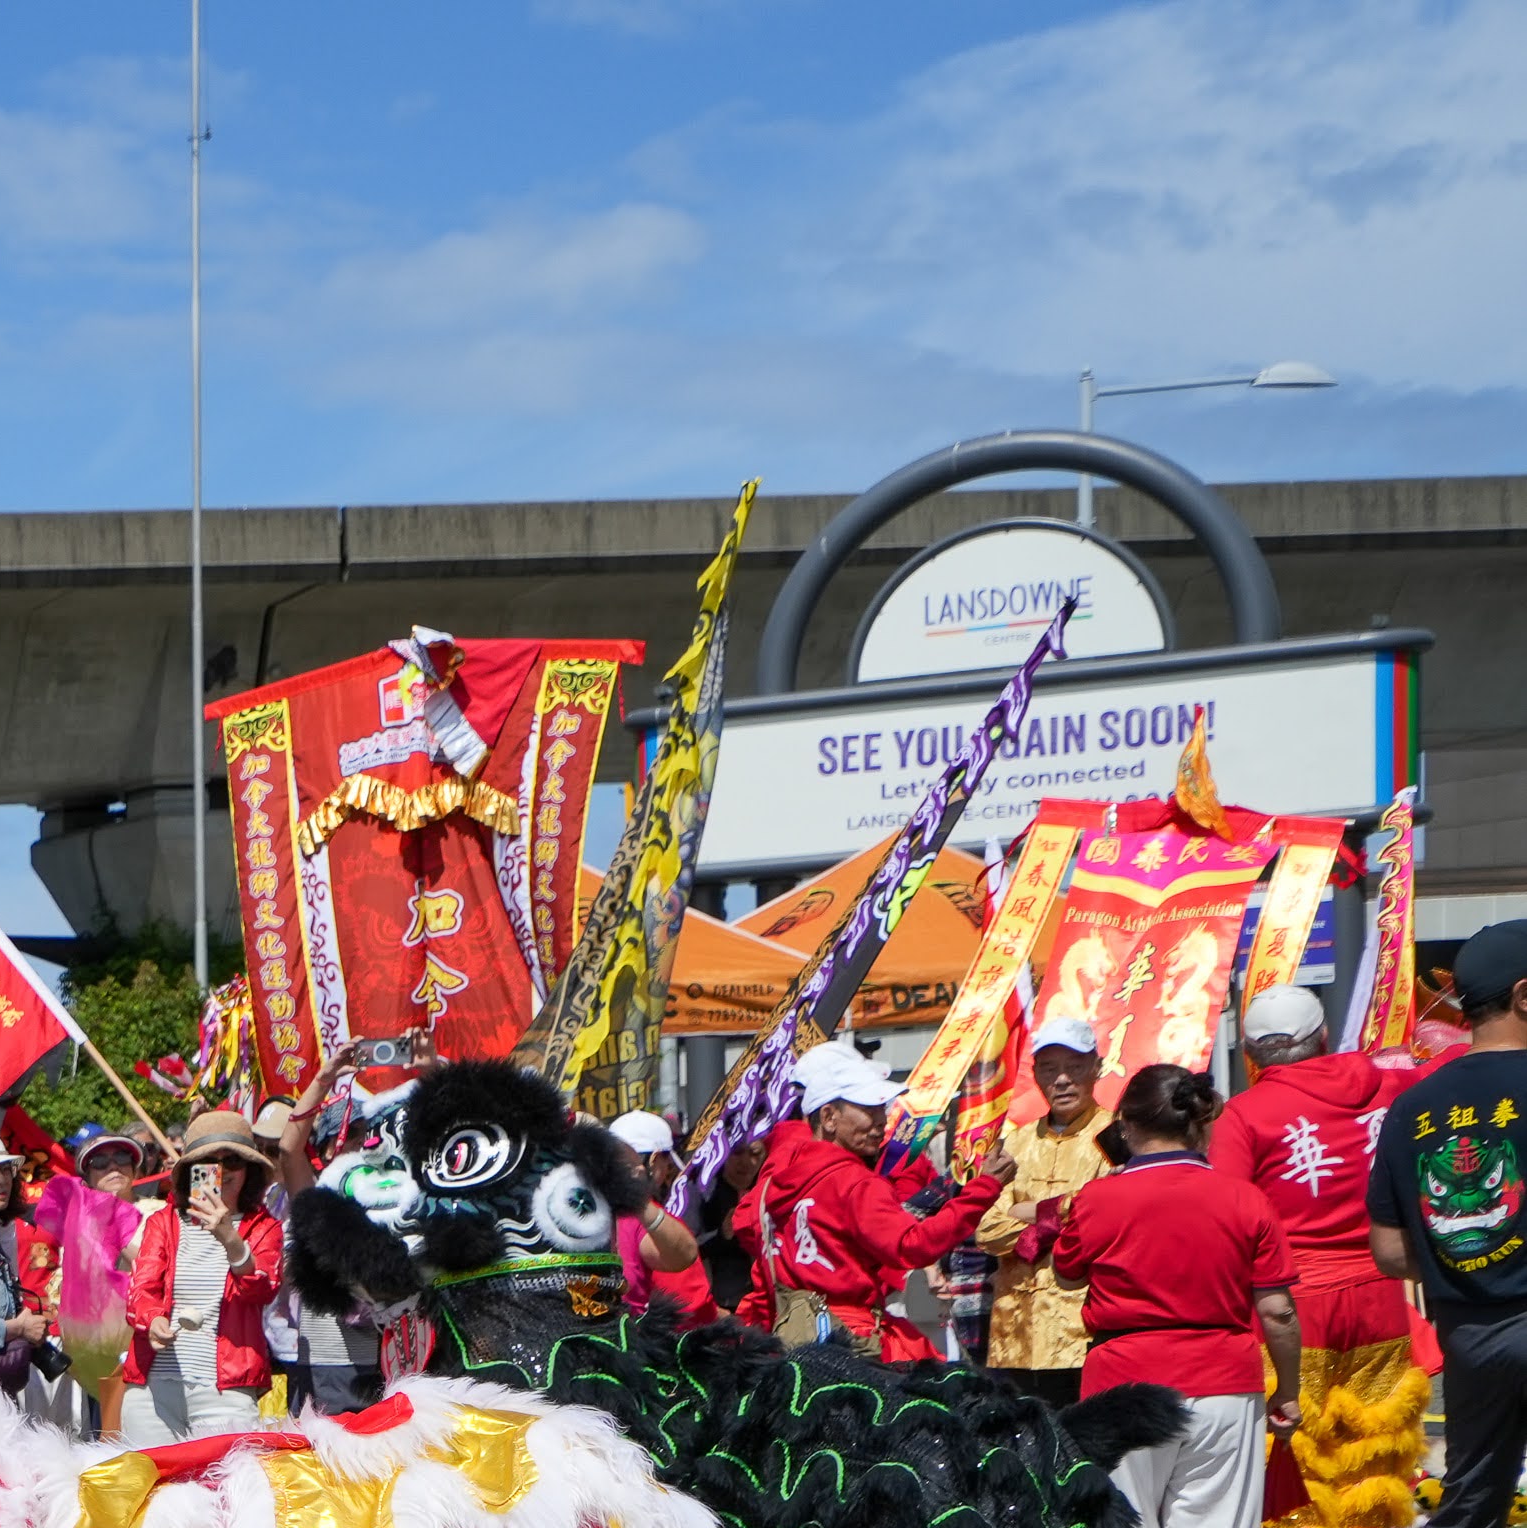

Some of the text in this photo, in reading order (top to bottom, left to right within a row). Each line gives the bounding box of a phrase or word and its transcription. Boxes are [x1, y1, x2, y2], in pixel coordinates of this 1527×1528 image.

[924, 575, 1093, 626] LANSDOWNE
[984, 632, 1032, 646] CENTRE
[818, 733, 882, 776] SEE
[893, 725, 963, 769] YOU
[1098, 700, 1216, 751] SOON!
[1006, 760, 1146, 790] connected
[1065, 906, 1119, 927] Paragon
[1167, 900, 1243, 922] Association
[1412, 1097, 1521, 1141] 五祖拳
